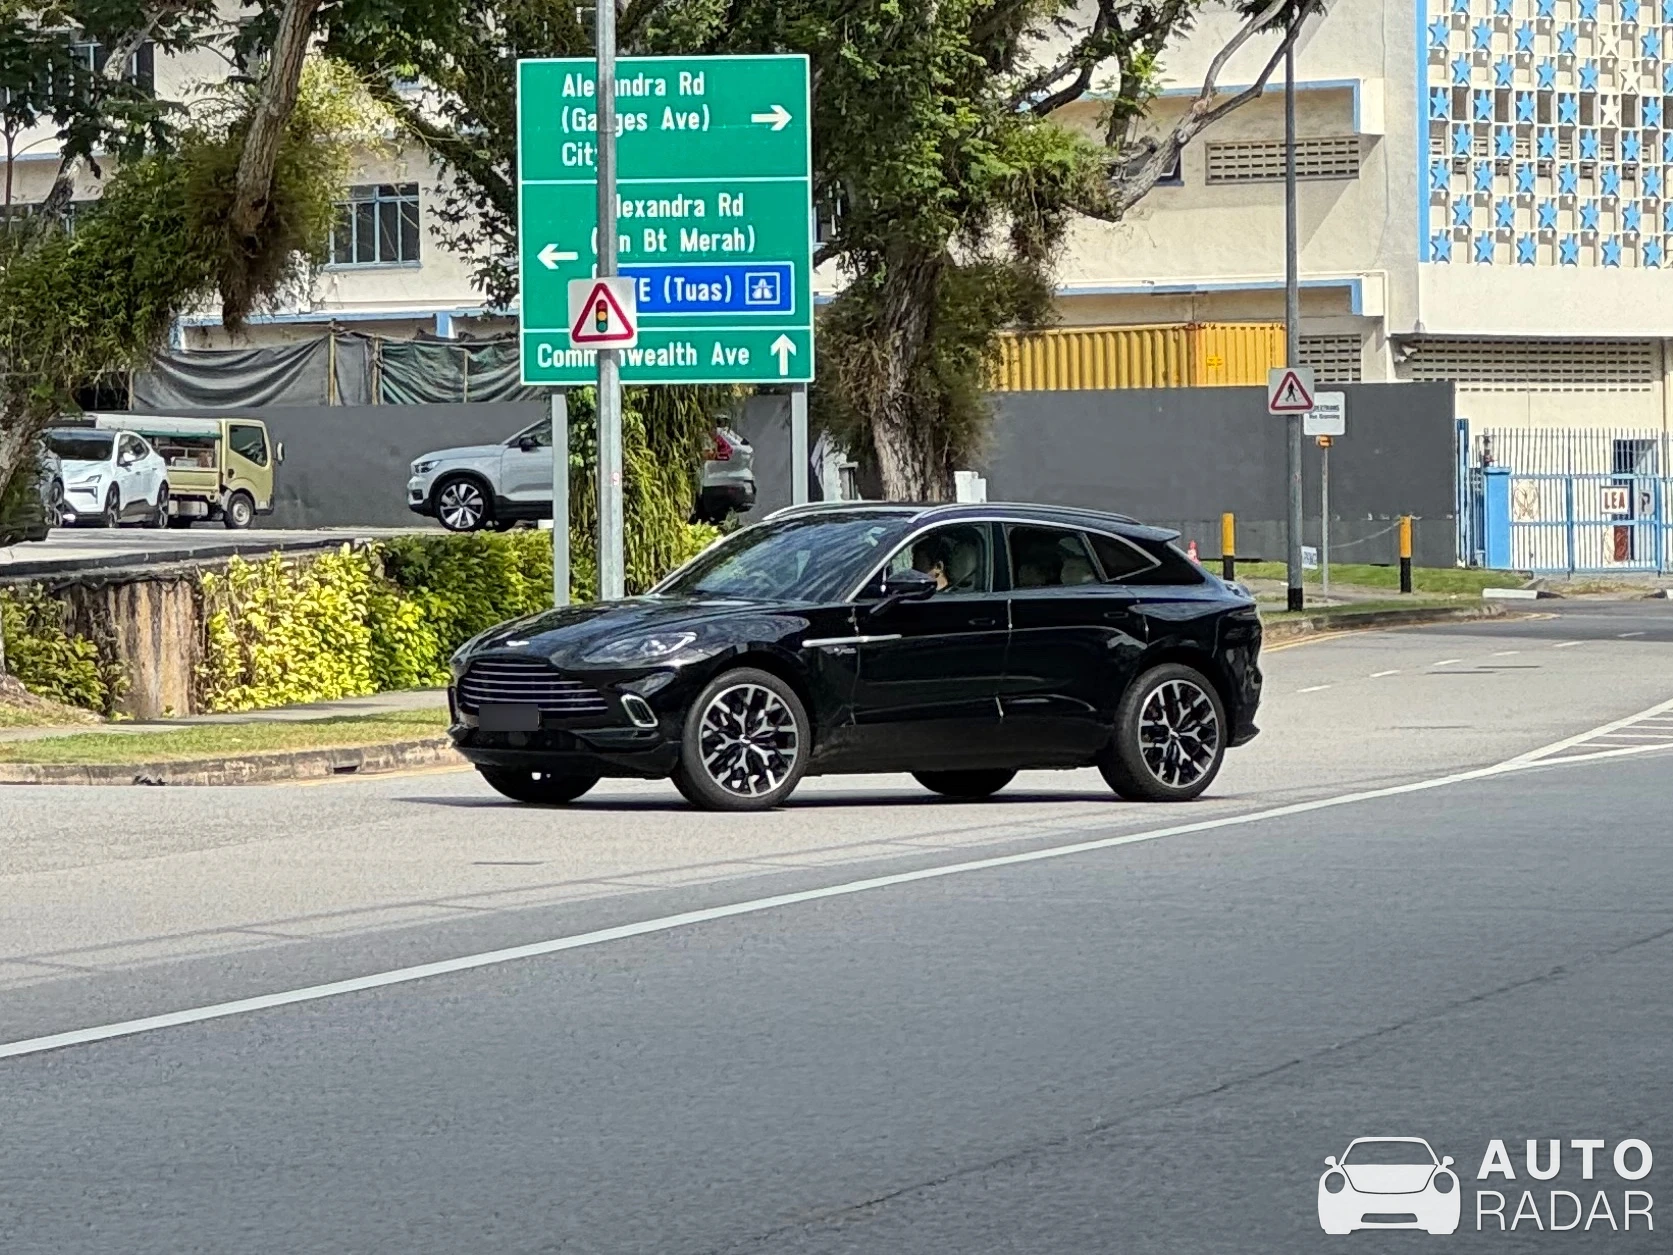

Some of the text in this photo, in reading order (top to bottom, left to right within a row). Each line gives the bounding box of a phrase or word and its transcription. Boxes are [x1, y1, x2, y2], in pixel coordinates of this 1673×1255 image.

[562, 71, 704, 97] Alendra Rd
[561, 103, 710, 138] (Gages Ave)
[562, 141, 598, 171] Cit
[616, 192, 743, 218] lexandra Rd
[643, 227, 667, 252] Bt
[680, 225, 755, 253] Merah)
[664, 275, 732, 303] (Tuas)
[711, 342, 749, 366] Ave
